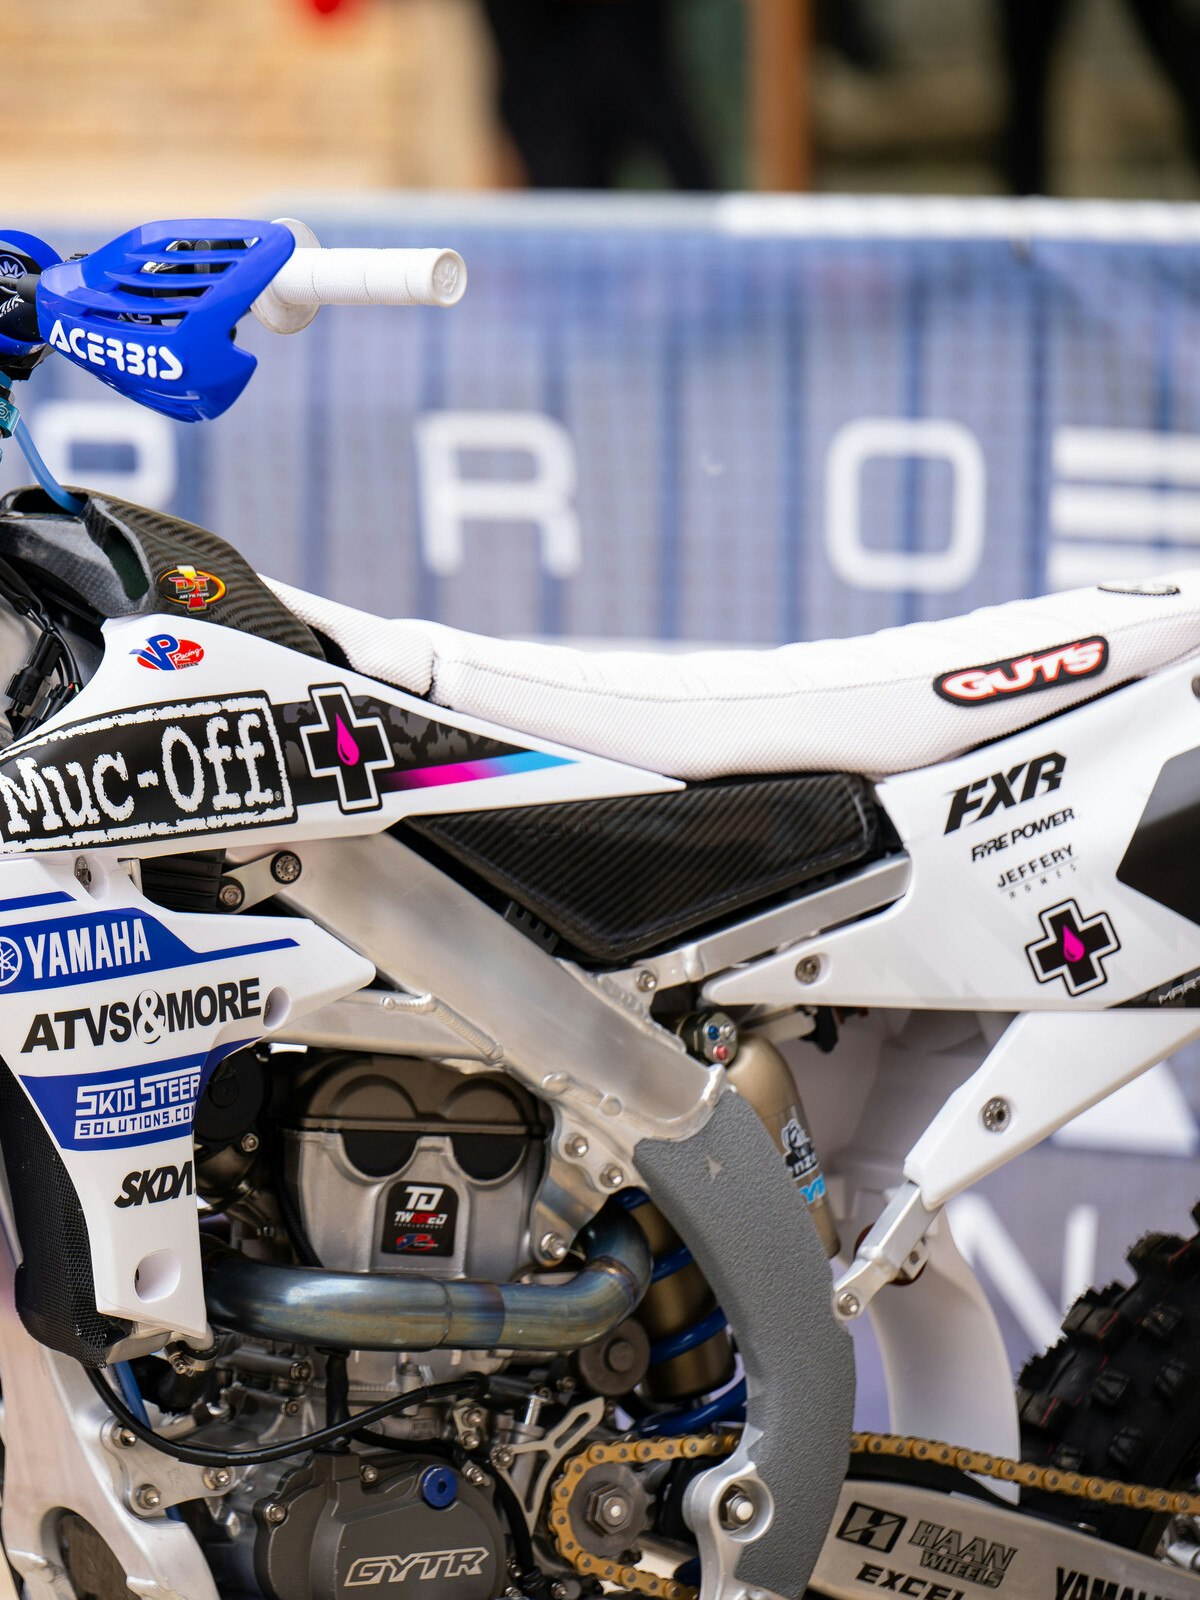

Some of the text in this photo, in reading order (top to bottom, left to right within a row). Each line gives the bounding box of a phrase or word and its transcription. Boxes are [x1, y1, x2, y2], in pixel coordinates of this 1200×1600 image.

[129, 634, 180, 671] VP
[942, 640, 1105, 701] GUTS
[0, 707, 279, 834] Muc-Off
[943, 751, 1067, 836] FXR
[1011, 807, 1076, 844] POWER
[997, 844, 1074, 888] JEFFERY
[23, 918, 151, 980] YAMAHA
[20, 977, 262, 1053] ATVS&MORE
[113, 1160, 194, 1209] SKDA
[344, 1546, 490, 1587] GYTR
[908, 1519, 1019, 1573] HAAN
